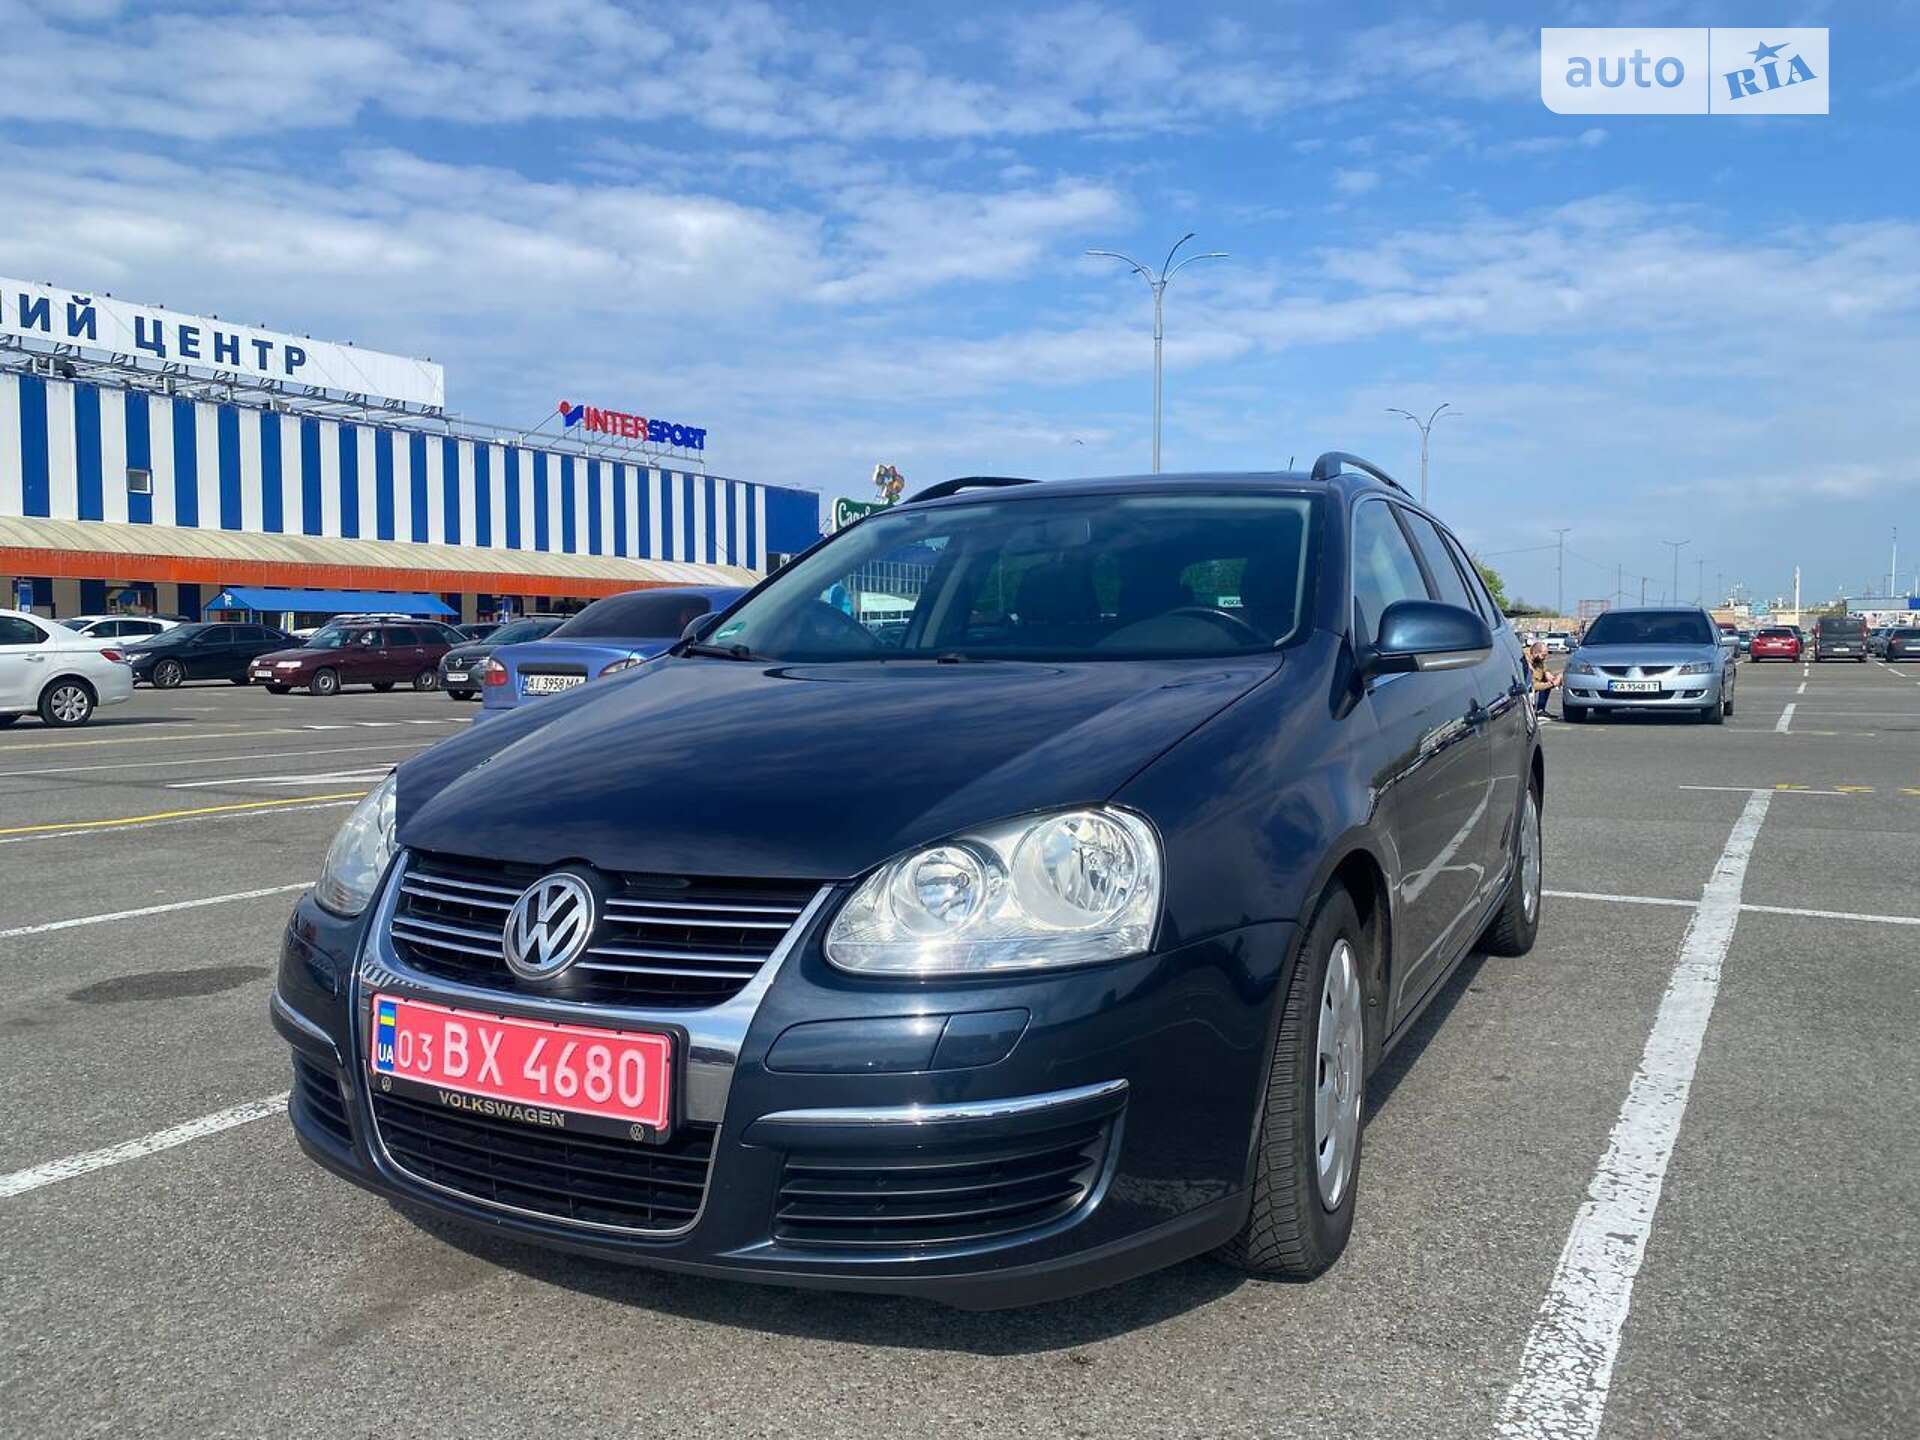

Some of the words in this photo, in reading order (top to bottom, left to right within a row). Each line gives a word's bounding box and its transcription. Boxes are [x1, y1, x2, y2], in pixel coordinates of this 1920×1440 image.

[0, 289, 97, 340] ИЙ
[134, 316, 307, 376] ЦЕНТР
[584, 406, 707, 450] INTERSPORT
[543, 677, 565, 690] 3958
[378, 1043, 394, 1064] UA
[398, 1030, 433, 1073] 03
[443, 1021, 504, 1086] BX
[523, 1037, 647, 1109] 4680
[439, 1091, 565, 1128] VOLKSWAGEN
